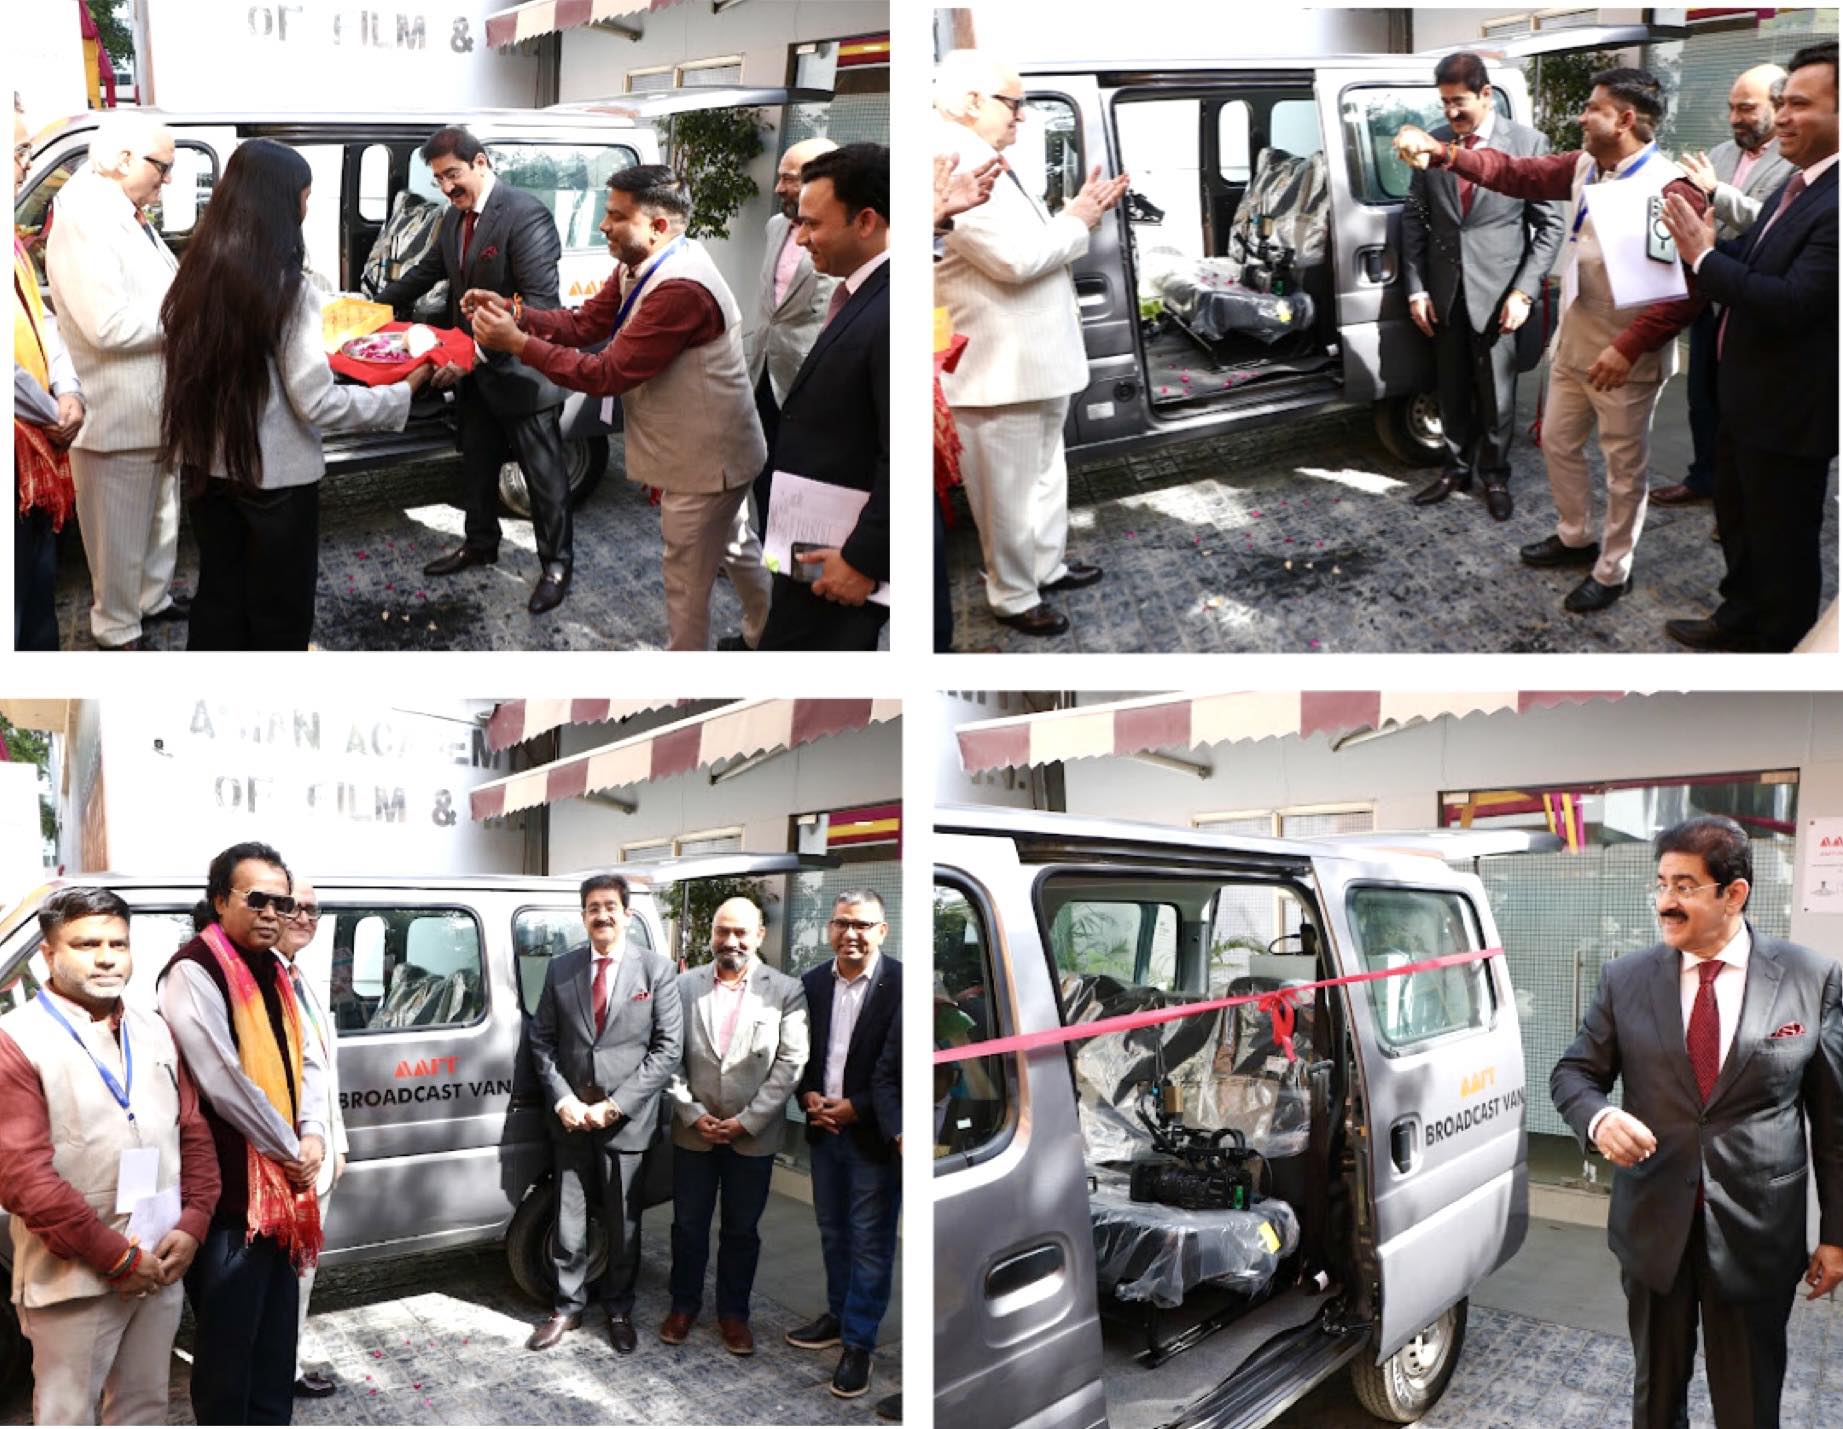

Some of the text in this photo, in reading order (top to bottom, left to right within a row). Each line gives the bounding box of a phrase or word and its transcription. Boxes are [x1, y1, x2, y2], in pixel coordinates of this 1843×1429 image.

[449, 16, 475, 53] &
[431, 788, 457, 827] &
[394, 1055, 461, 1079] AAFT
[339, 1079, 512, 1110] BROADCAST VAN
[1425, 1086, 1526, 1146] BROADCAST VAN
